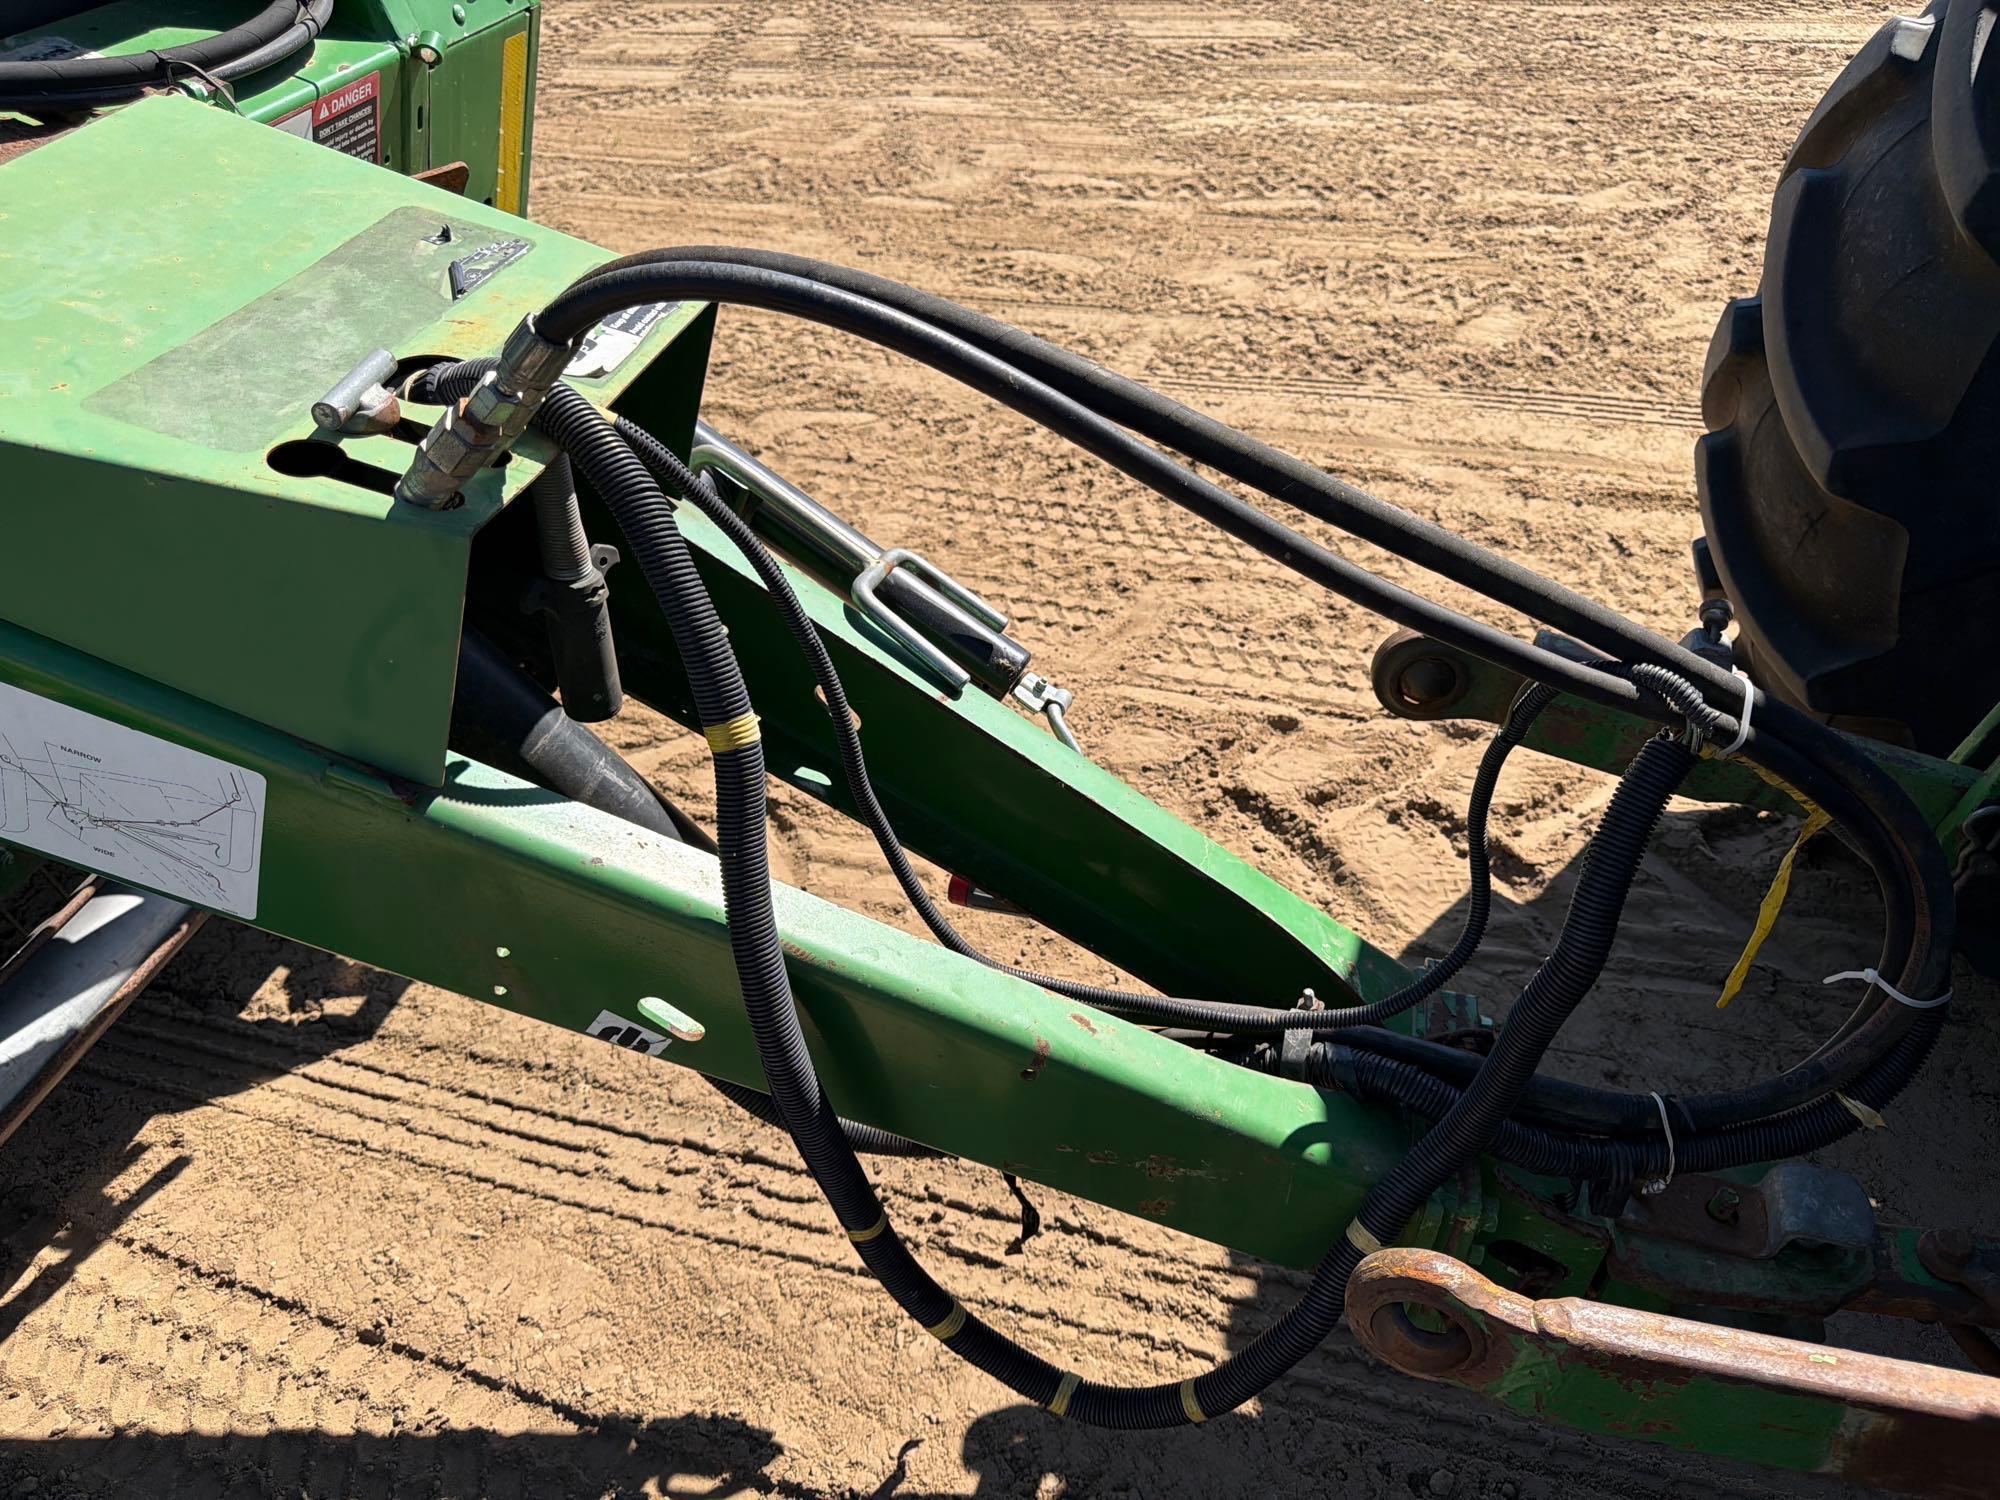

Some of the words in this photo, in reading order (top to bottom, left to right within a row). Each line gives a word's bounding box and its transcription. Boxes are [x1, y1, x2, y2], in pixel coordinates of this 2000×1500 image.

[331, 82, 372, 113] DANGER
[319, 124, 335, 139] DON'T
[335, 117, 348, 132] TAKE
[348, 105, 373, 124] CHANCES!
[335, 132, 348, 143] injury
[355, 121, 368, 132] death
[367, 118, 374, 127] by
[350, 135, 358, 143] the
[60, 744, 102, 764] NARROW
[92, 845, 116, 858] WIDE
